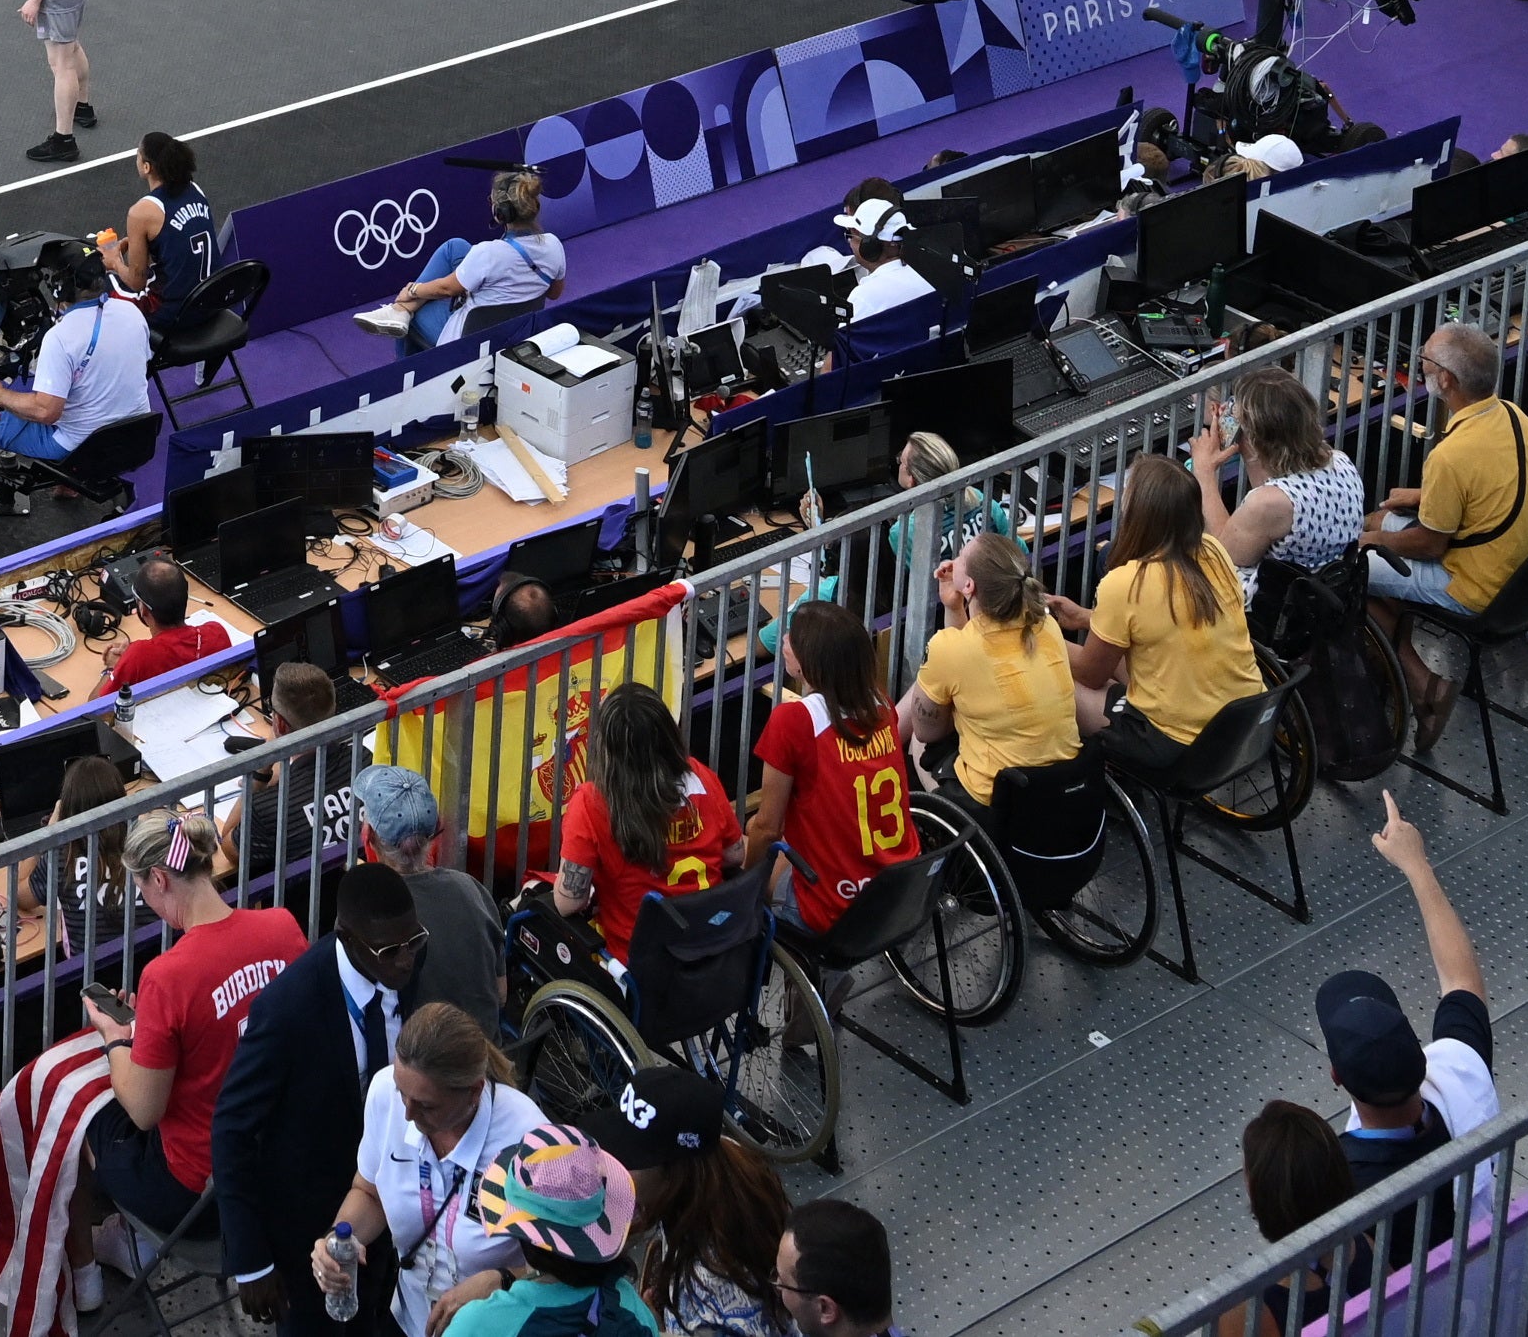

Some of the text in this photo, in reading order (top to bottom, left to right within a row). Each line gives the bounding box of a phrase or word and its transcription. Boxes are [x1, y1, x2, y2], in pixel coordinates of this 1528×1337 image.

[169, 202, 211, 232] BURDICK
[189, 230, 212, 283] 7
[853, 766, 906, 857] 13
